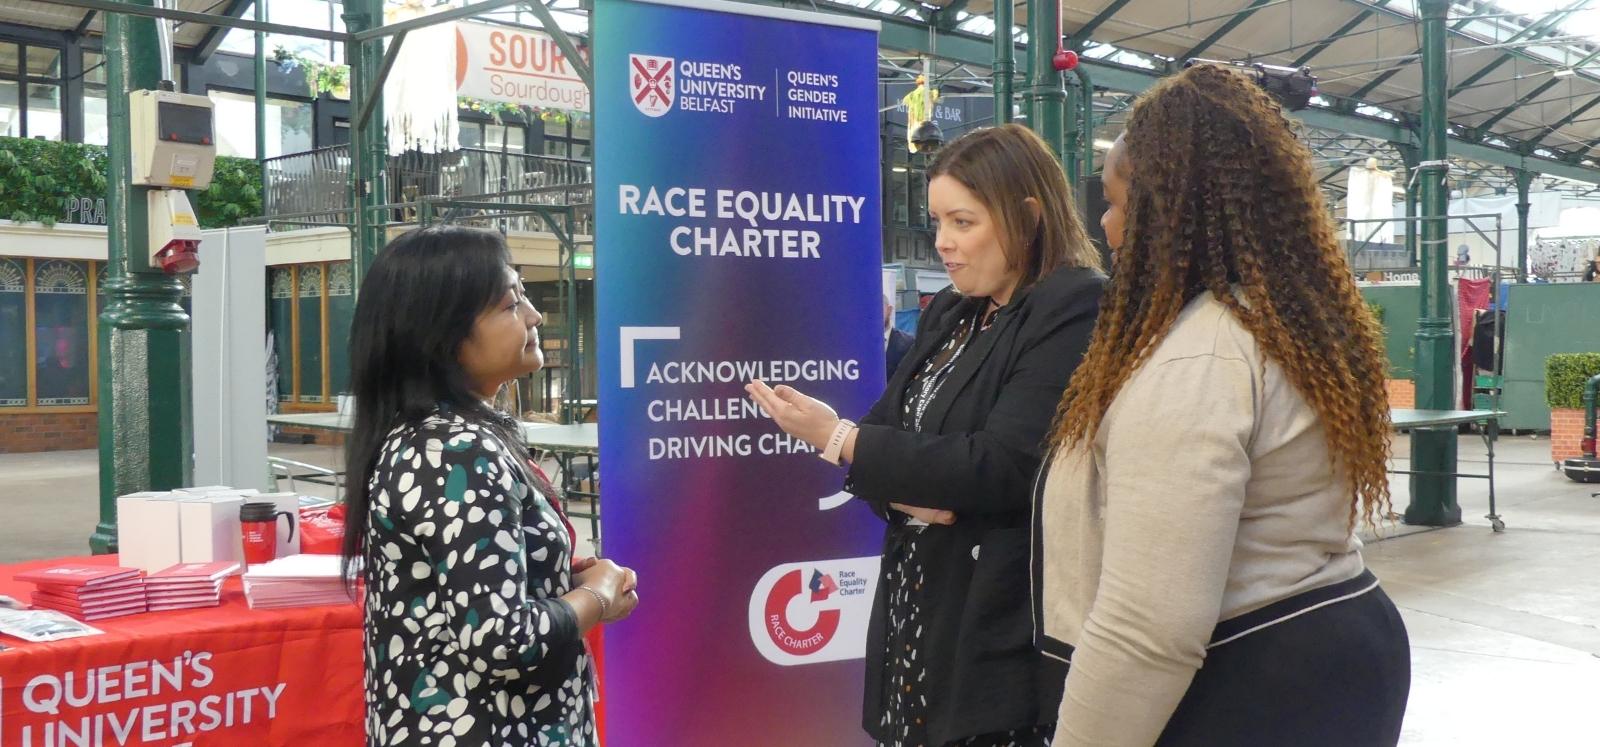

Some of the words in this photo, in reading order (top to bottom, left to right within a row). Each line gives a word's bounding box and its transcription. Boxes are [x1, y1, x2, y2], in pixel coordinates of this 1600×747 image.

[680, 61, 741, 81] QUEEN'S
[787, 71, 839, 88] QUEEN'S
[680, 80, 766, 100] UNIVERSITY
[788, 89, 837, 105] GENDER
[680, 97, 735, 114] BELFAST
[788, 106, 848, 122] INITIATIVE
[944, 106, 962, 122] BAR
[619, 184, 706, 218] RACE
[717, 189, 866, 227] EQUALITY
[670, 226, 821, 259] CHARTER
[1383, 272, 1419, 282] Home
[646, 359, 860, 384] ACKNOWLEDGING
[649, 434, 752, 460] DRIVING
[839, 570, 856, 578] Race
[839, 577, 867, 588] Equality
[839, 588, 866, 596] Charter
[770, 614, 786, 639] RACE
[784, 632, 824, 649] CHARTER
[22, 650, 214, 715] QUEEN'S
[22, 682, 287, 747] UNIVERSITY
